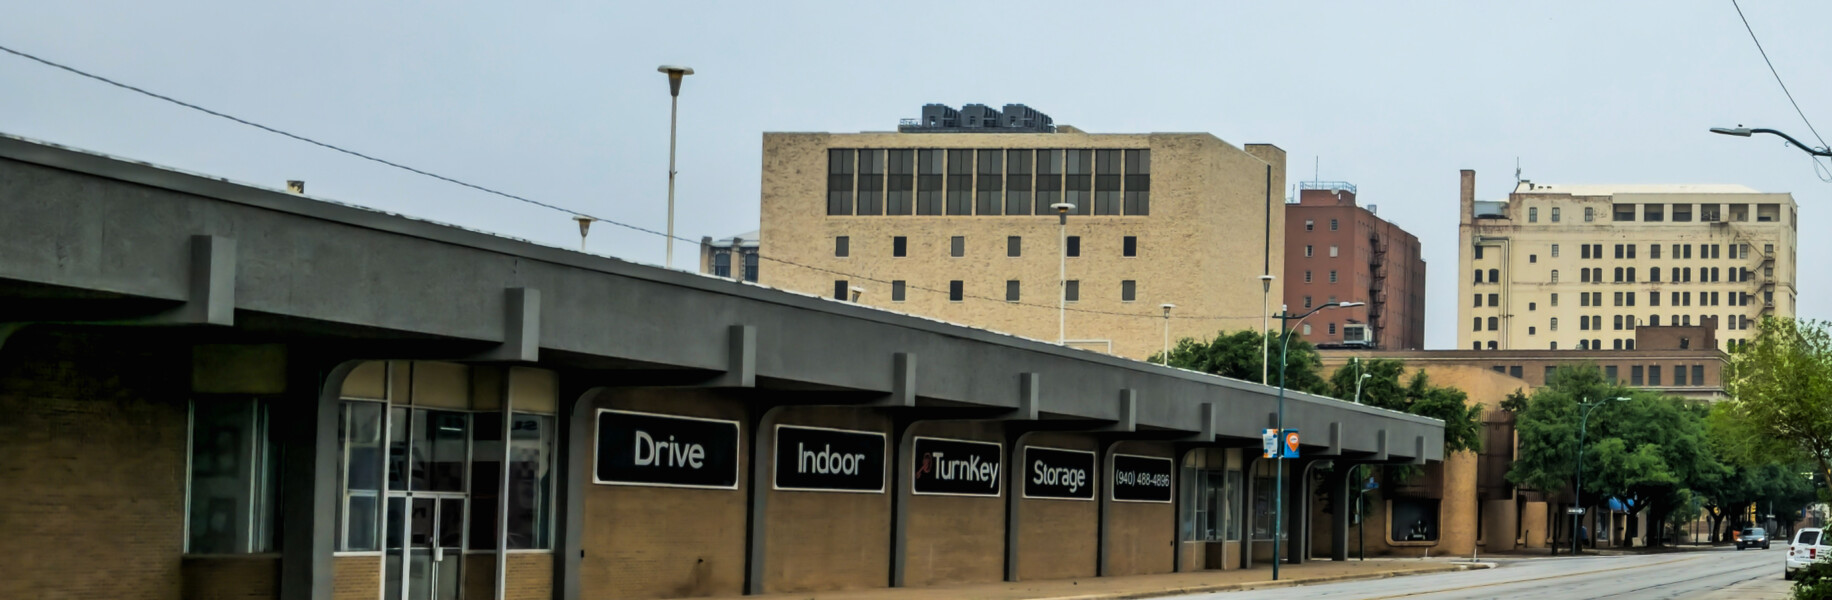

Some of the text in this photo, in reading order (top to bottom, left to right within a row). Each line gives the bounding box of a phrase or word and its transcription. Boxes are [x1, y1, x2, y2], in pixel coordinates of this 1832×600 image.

[634, 430, 705, 469] Drive
[798, 442, 865, 475] Indoor
[932, 452, 999, 488] TurnKey
[1033, 459, 1086, 493] Storage
[1115, 469, 1136, 487] (940)
